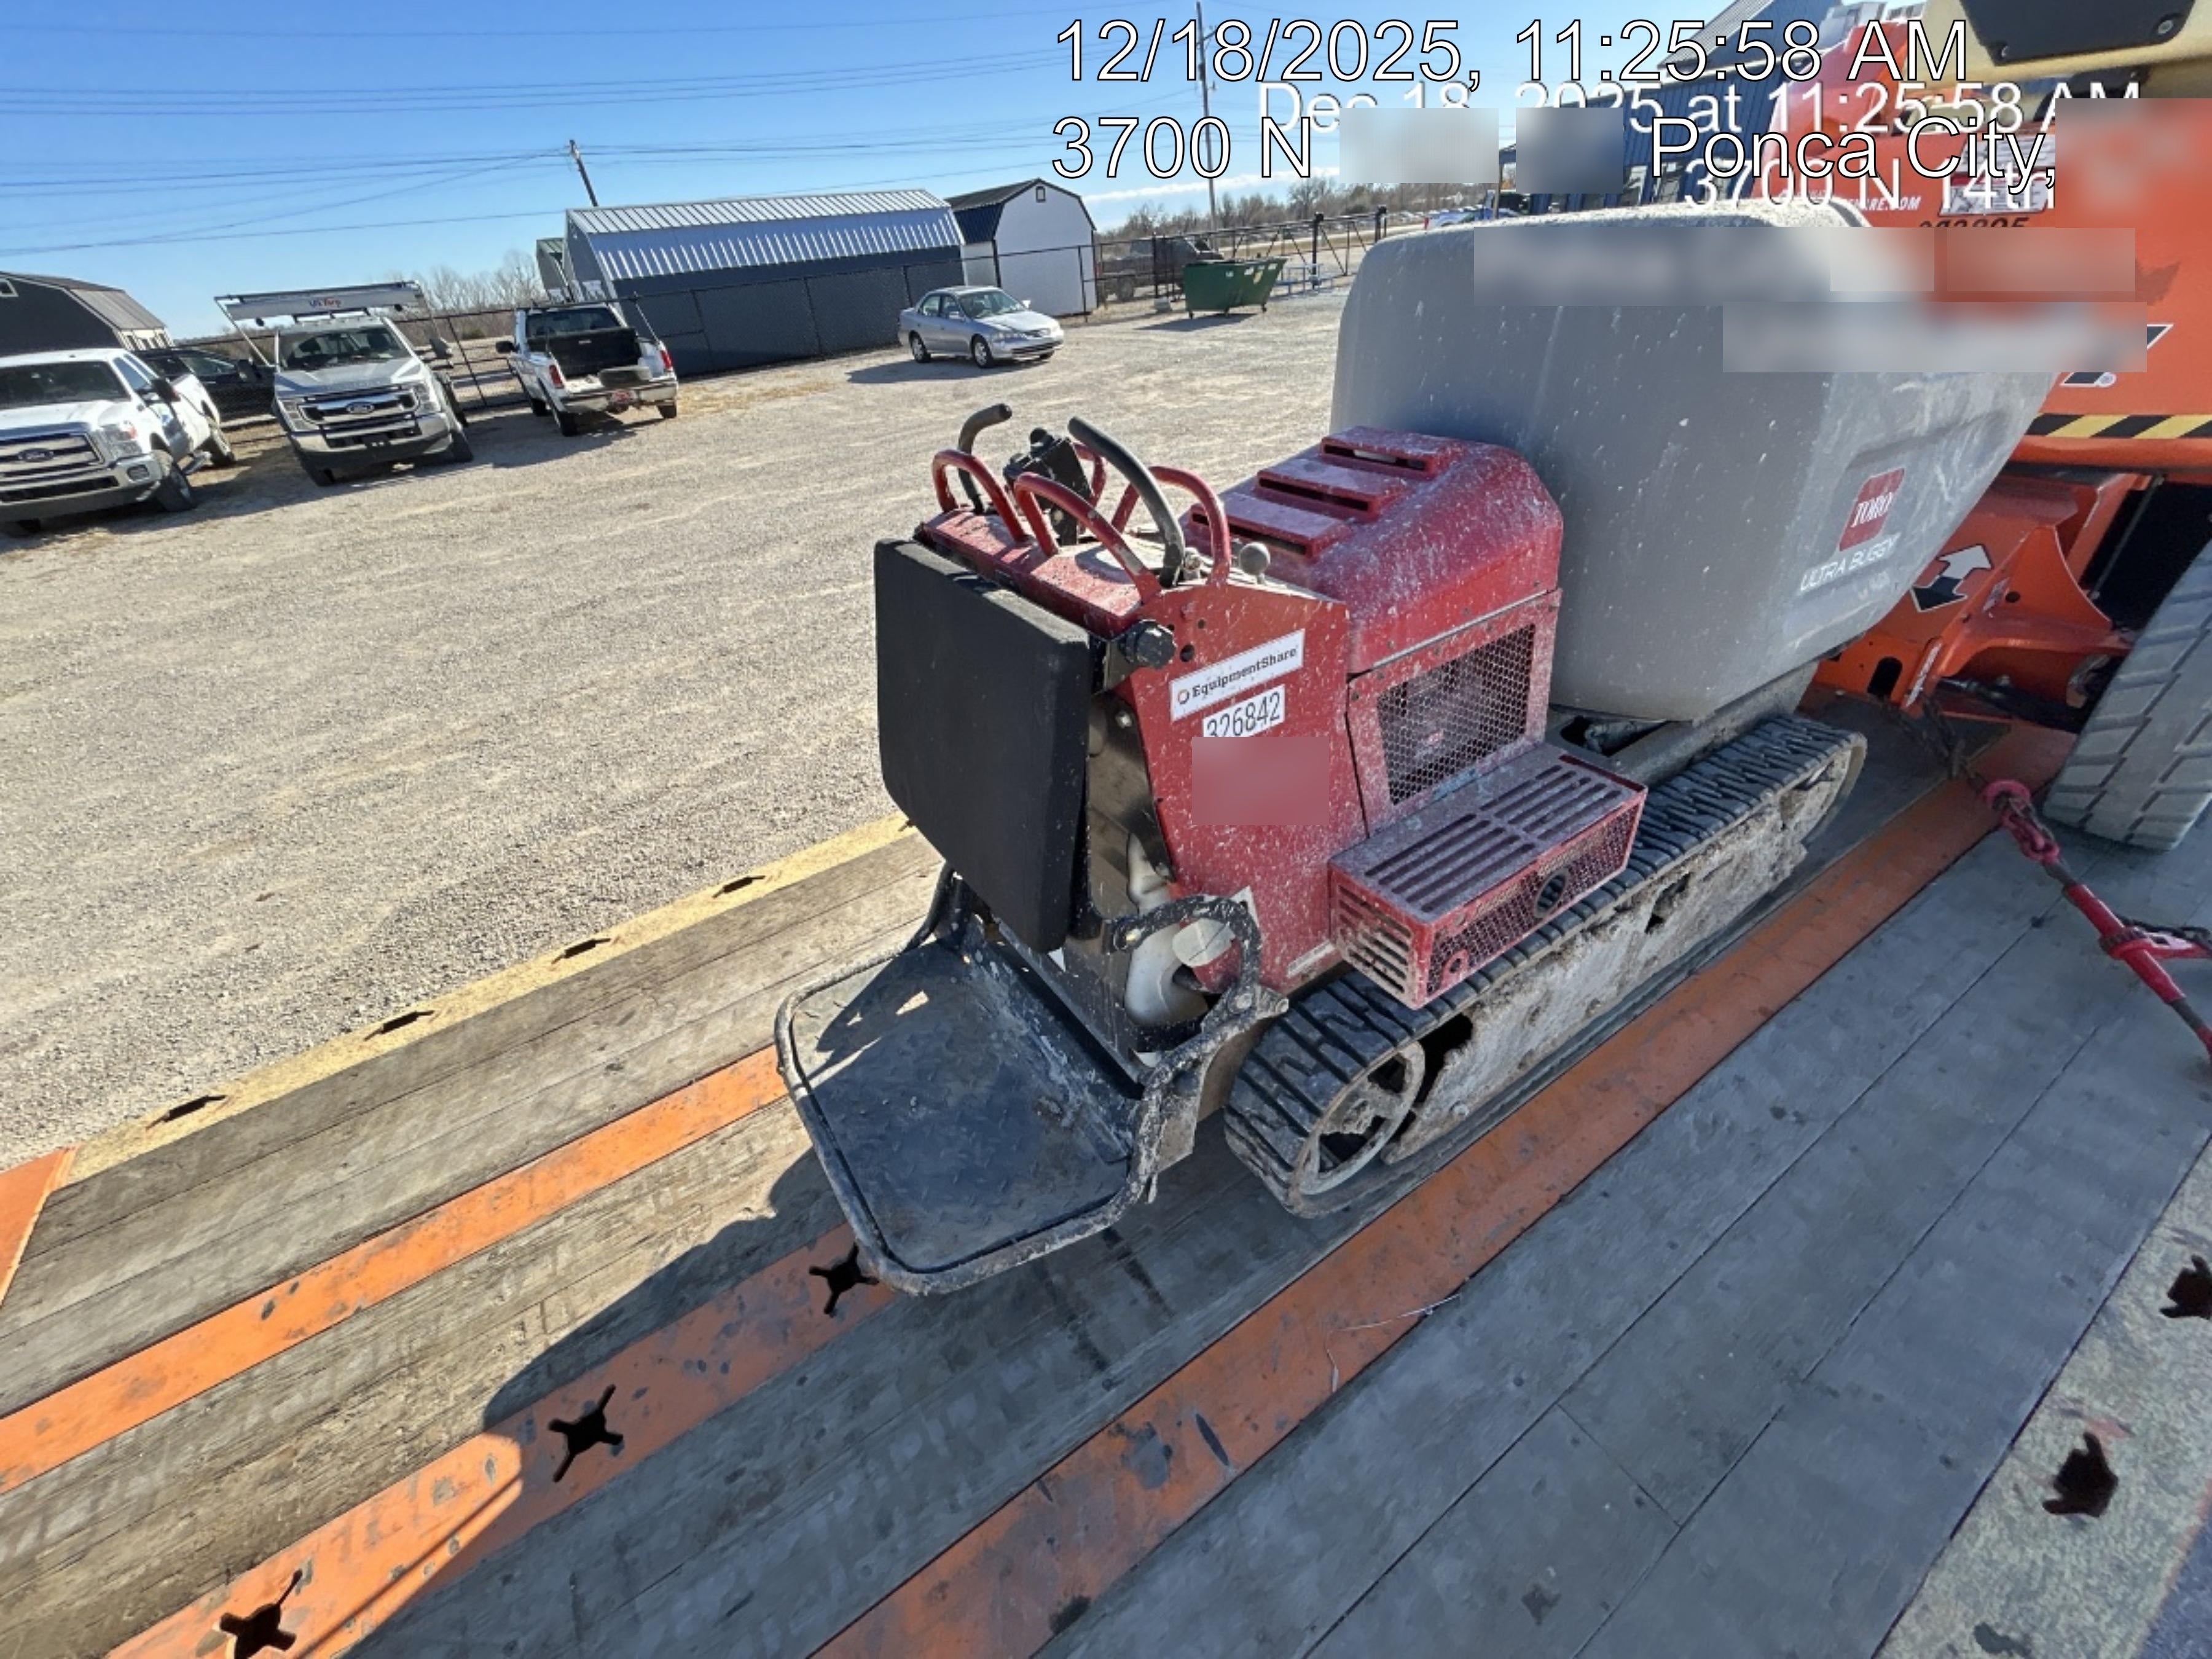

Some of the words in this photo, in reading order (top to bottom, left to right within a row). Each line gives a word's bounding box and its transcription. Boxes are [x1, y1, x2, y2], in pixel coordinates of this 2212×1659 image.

[1850, 492, 1892, 528] TORO
[1800, 558, 1846, 592] ULTRA
[1192, 647, 1298, 698] EquipmentShare
[1207, 691, 1281, 737] 326842
